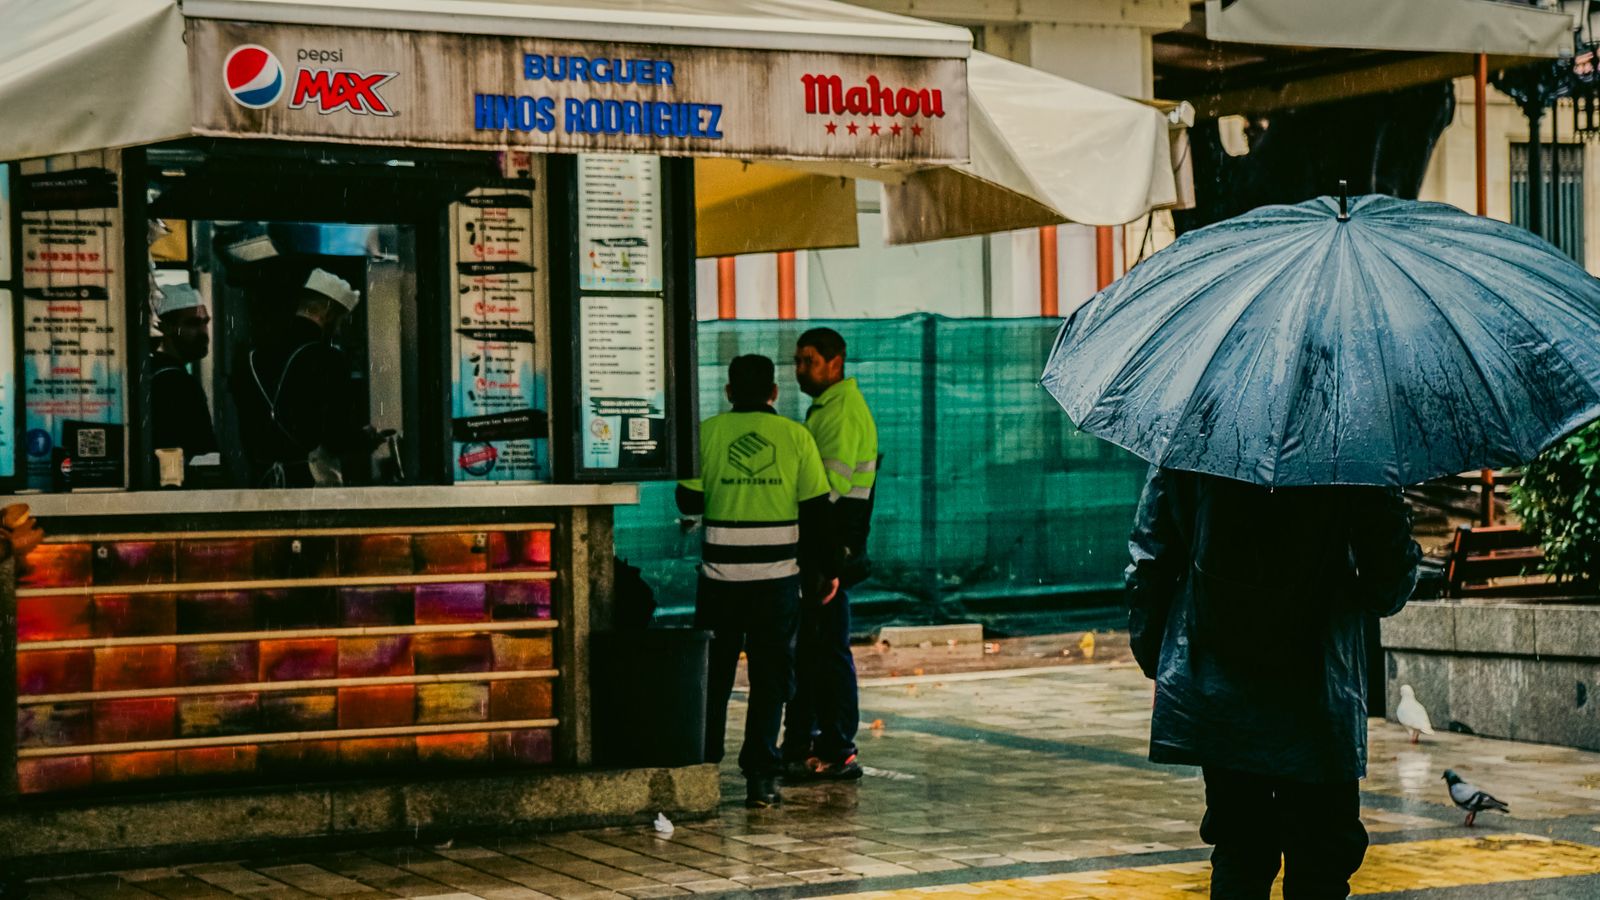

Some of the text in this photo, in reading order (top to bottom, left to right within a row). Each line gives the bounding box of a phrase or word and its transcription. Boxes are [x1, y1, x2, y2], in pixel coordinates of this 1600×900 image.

[297, 49, 343, 65] pepsi
[524, 53, 675, 85] BURGUER
[289, 66, 400, 117] MAX
[801, 73, 946, 119] Mahou
[474, 93, 723, 139] HNOS RODRIGUEZ
